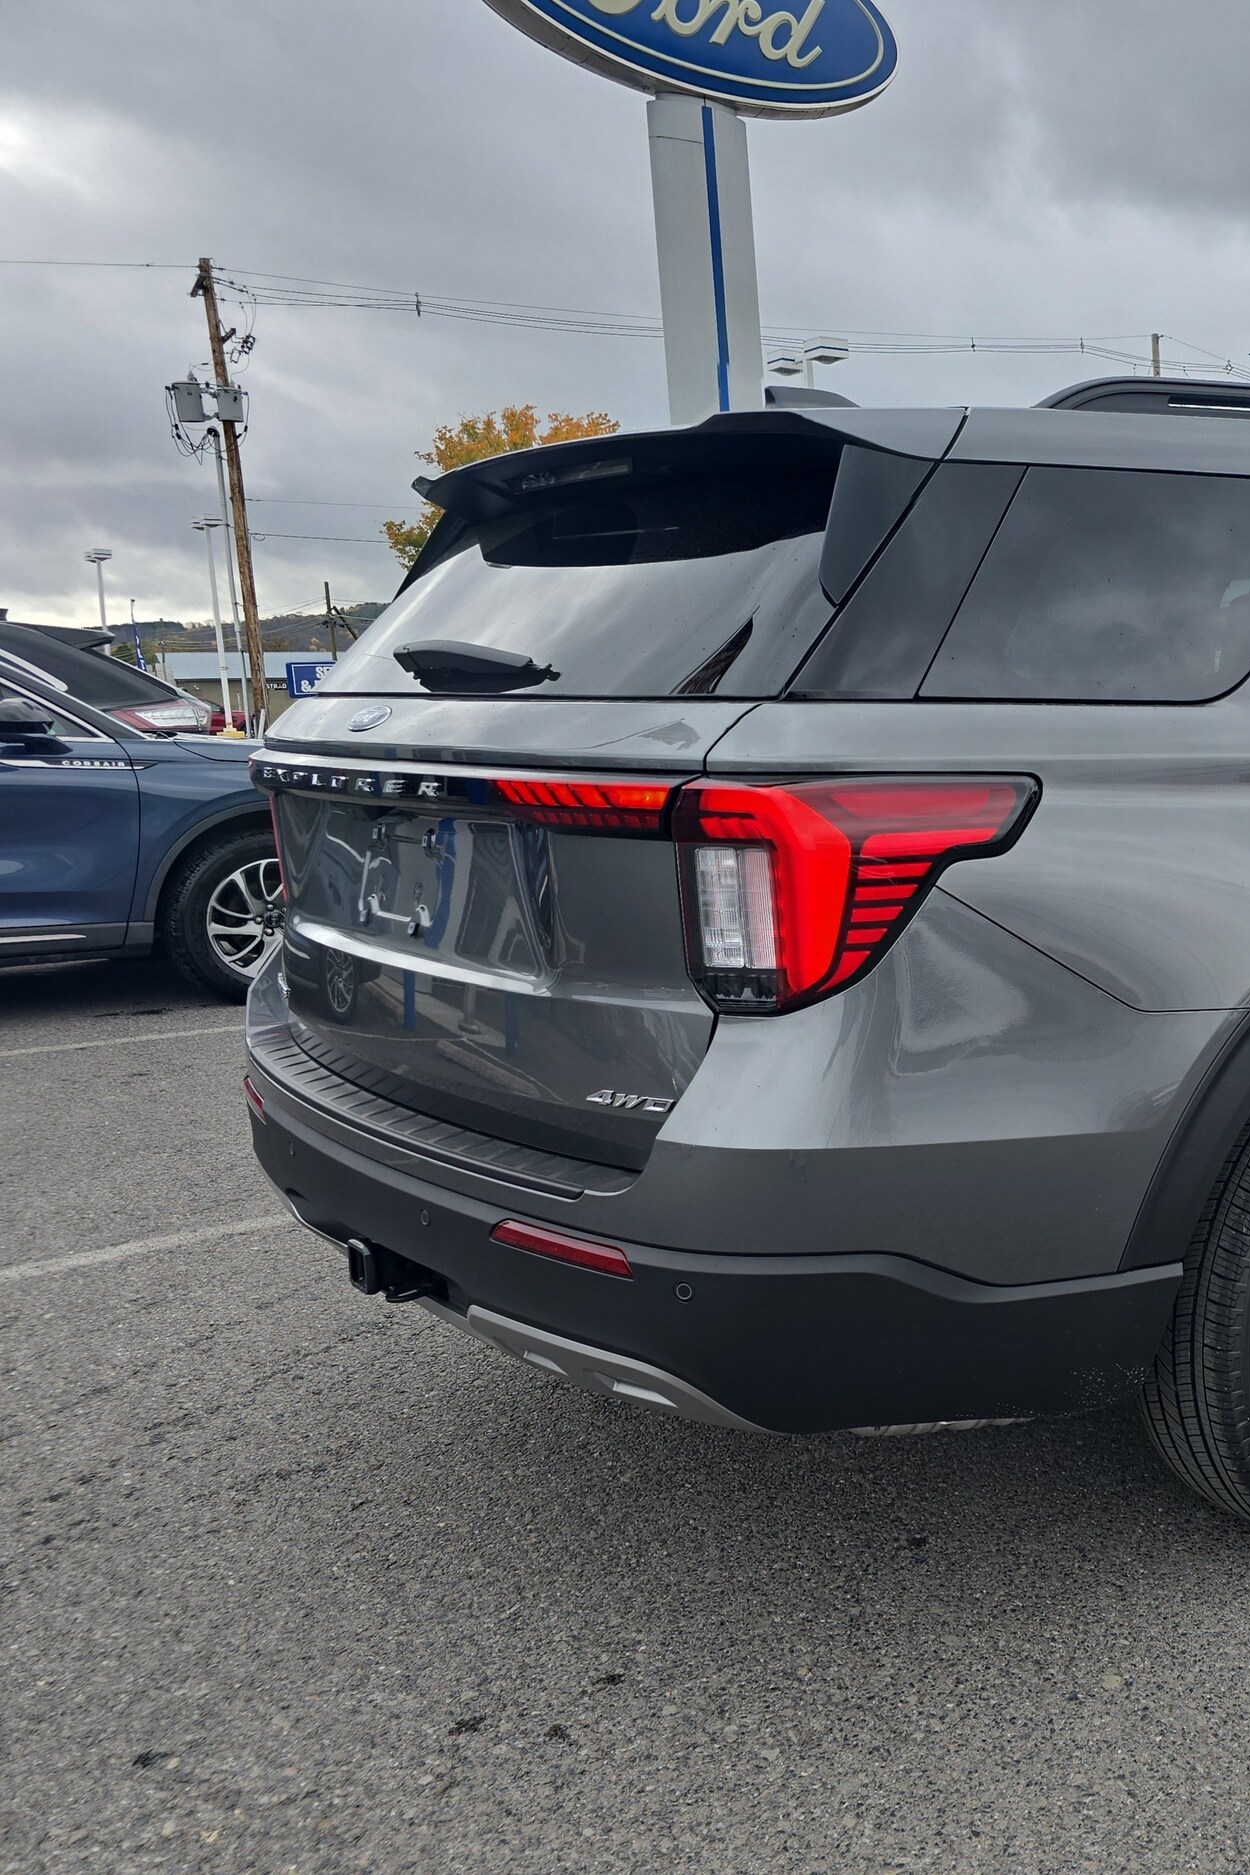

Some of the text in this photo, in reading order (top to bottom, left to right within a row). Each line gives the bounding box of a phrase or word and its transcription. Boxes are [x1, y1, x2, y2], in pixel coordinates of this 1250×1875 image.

[588, 0, 826, 68] ord
[263, 766, 442, 797] EXPLORER
[585, 1090, 676, 1112] 4WD
